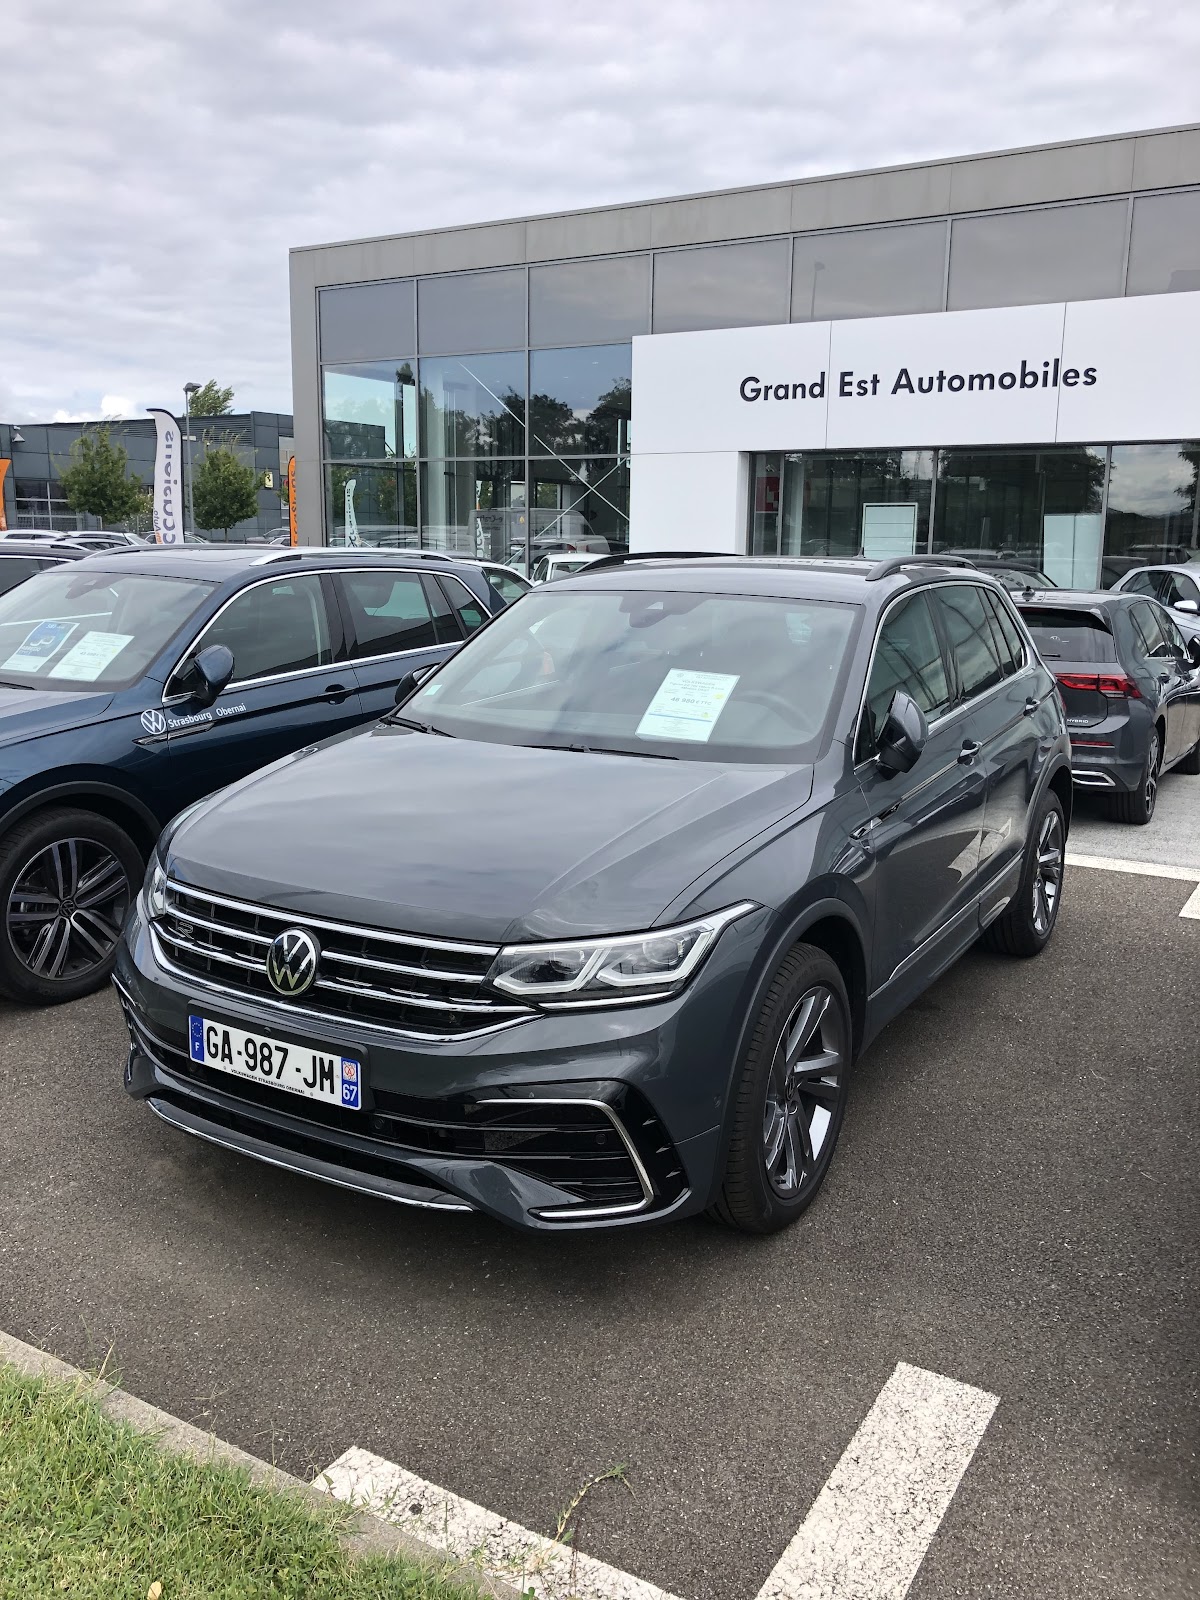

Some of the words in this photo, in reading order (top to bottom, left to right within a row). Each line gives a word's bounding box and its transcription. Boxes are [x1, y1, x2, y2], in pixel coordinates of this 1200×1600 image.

[740, 371, 826, 402] Grand
[839, 371, 880, 397] Est
[891, 358, 1098, 394] Automobiles
[168, 711, 213, 728] Strasbourg
[216, 703, 247, 717] Obernai
[195, 1042, 200, 1051] F
[206, 1026, 335, 1094] GA-987-JM
[258, 1077, 286, 1089] STRASBOURG
[286, 1085, 305, 1095] OBERNAI
[343, 1084, 358, 1102] 67
